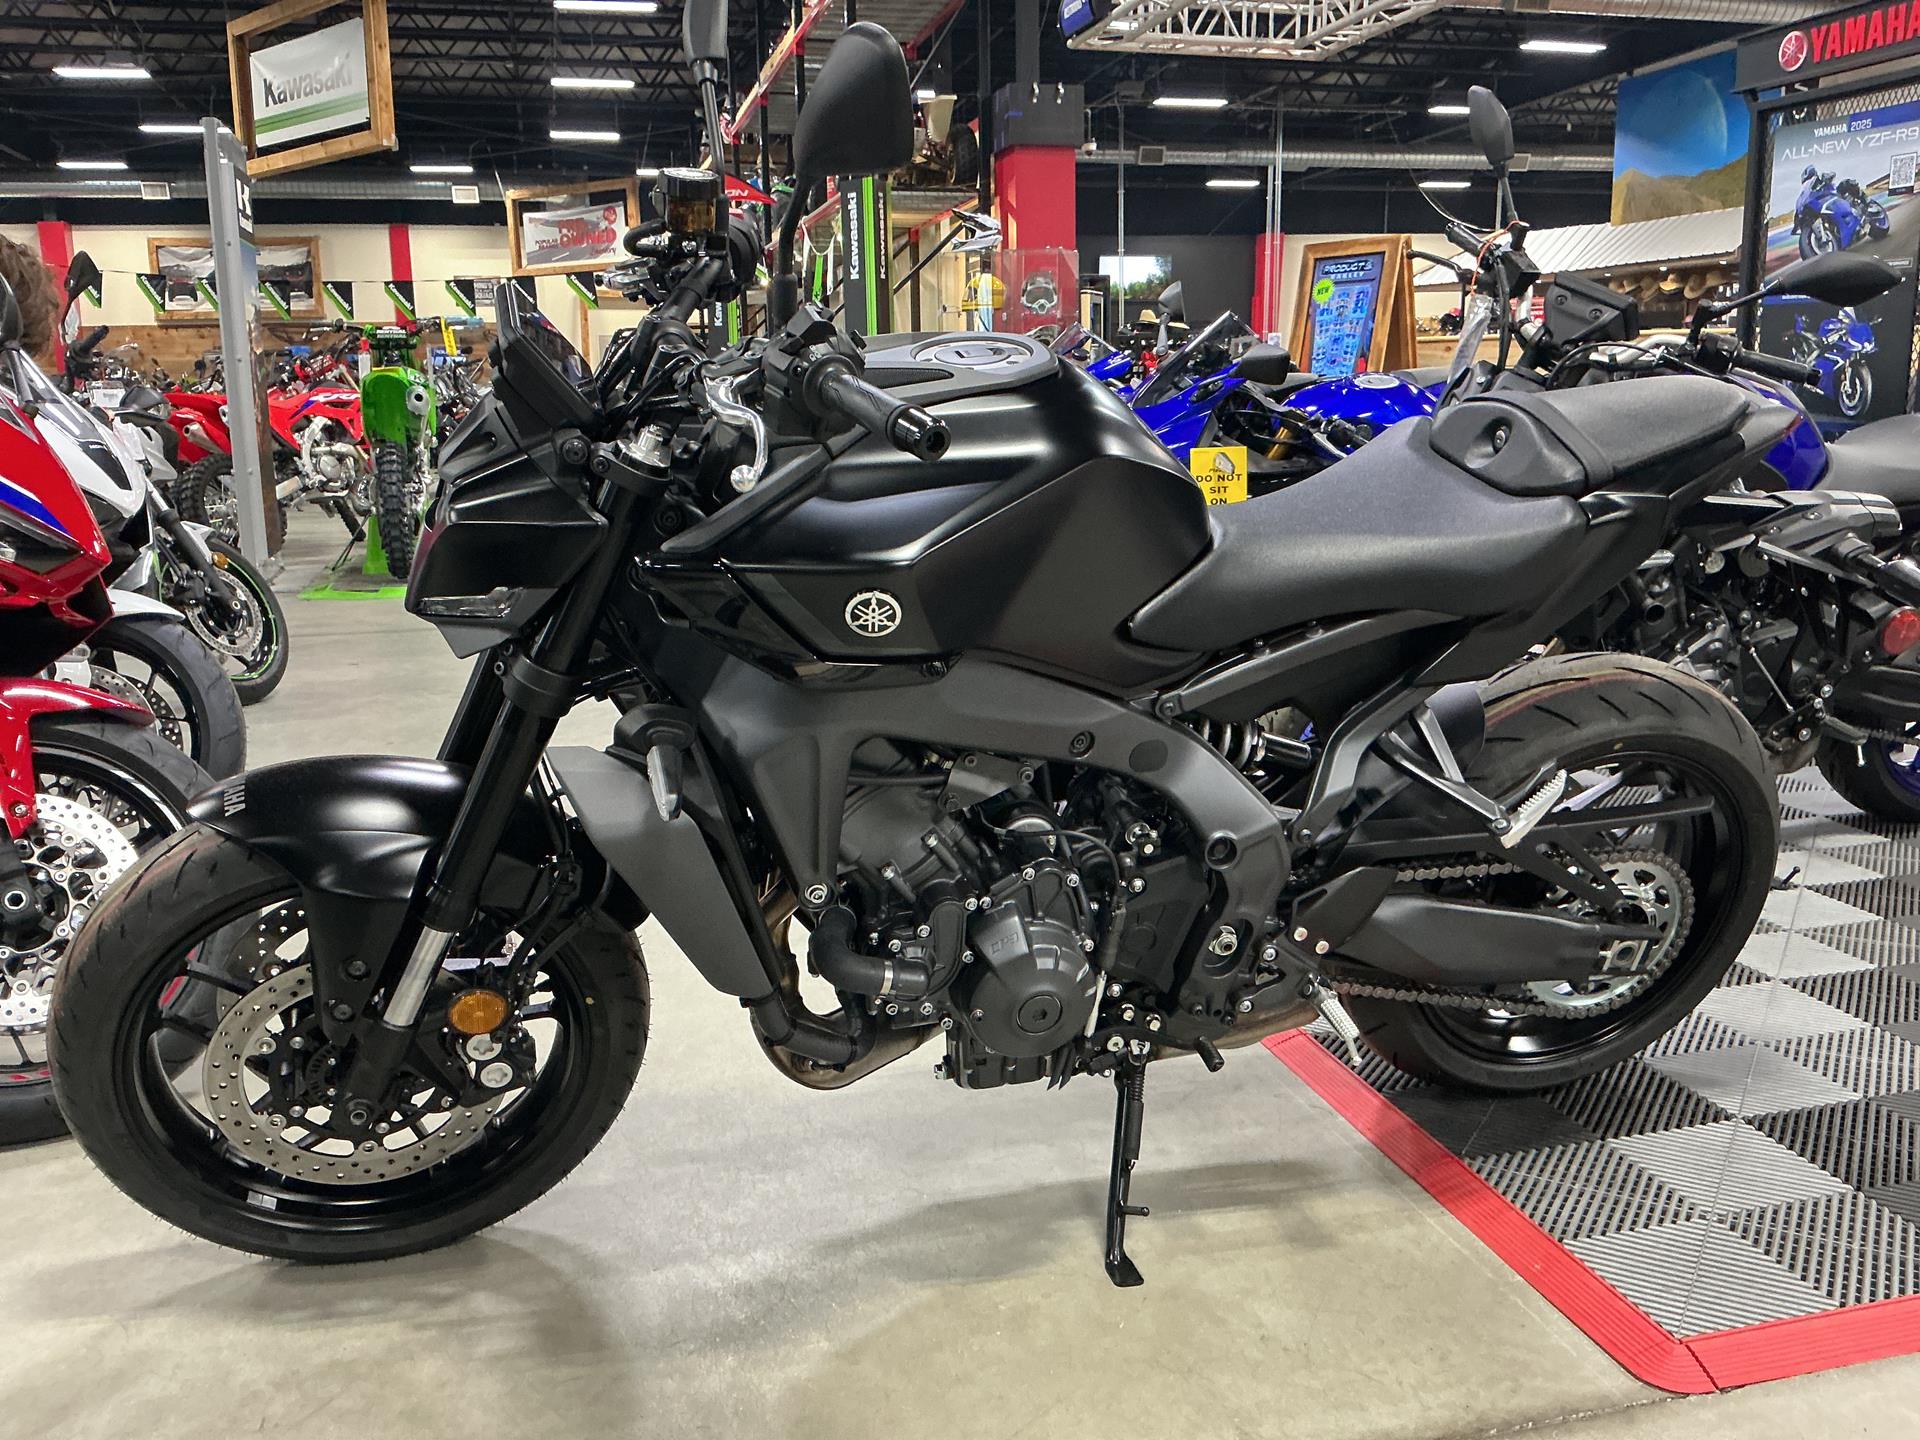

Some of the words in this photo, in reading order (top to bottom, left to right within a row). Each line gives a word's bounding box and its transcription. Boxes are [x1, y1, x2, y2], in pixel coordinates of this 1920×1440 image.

[1811, 0, 1920, 64] YAMAHA
[263, 52, 352, 108] Kawasaki
[1813, 123, 1848, 138] YAMAHA
[1850, 118, 1873, 132] 2025
[1781, 138, 1851, 161] ALL-NEW
[1856, 126, 1919, 149] YZF-R9
[848, 191, 860, 280] Kawasaki
[878, 191, 886, 280] Kawasaki
[140, 274, 164, 305] Kawasaki
[264, 281, 289, 310] Kawasaki
[326, 283, 352, 311] Kawasaki
[388, 283, 414, 310] Kawasaki
[449, 281, 475, 308] Kawasaki
[570, 274, 596, 300] Kawasaki
[1196, 475, 1213, 483] DO
[1217, 473, 1242, 482] NOT
[1209, 486, 1229, 494] SIT
